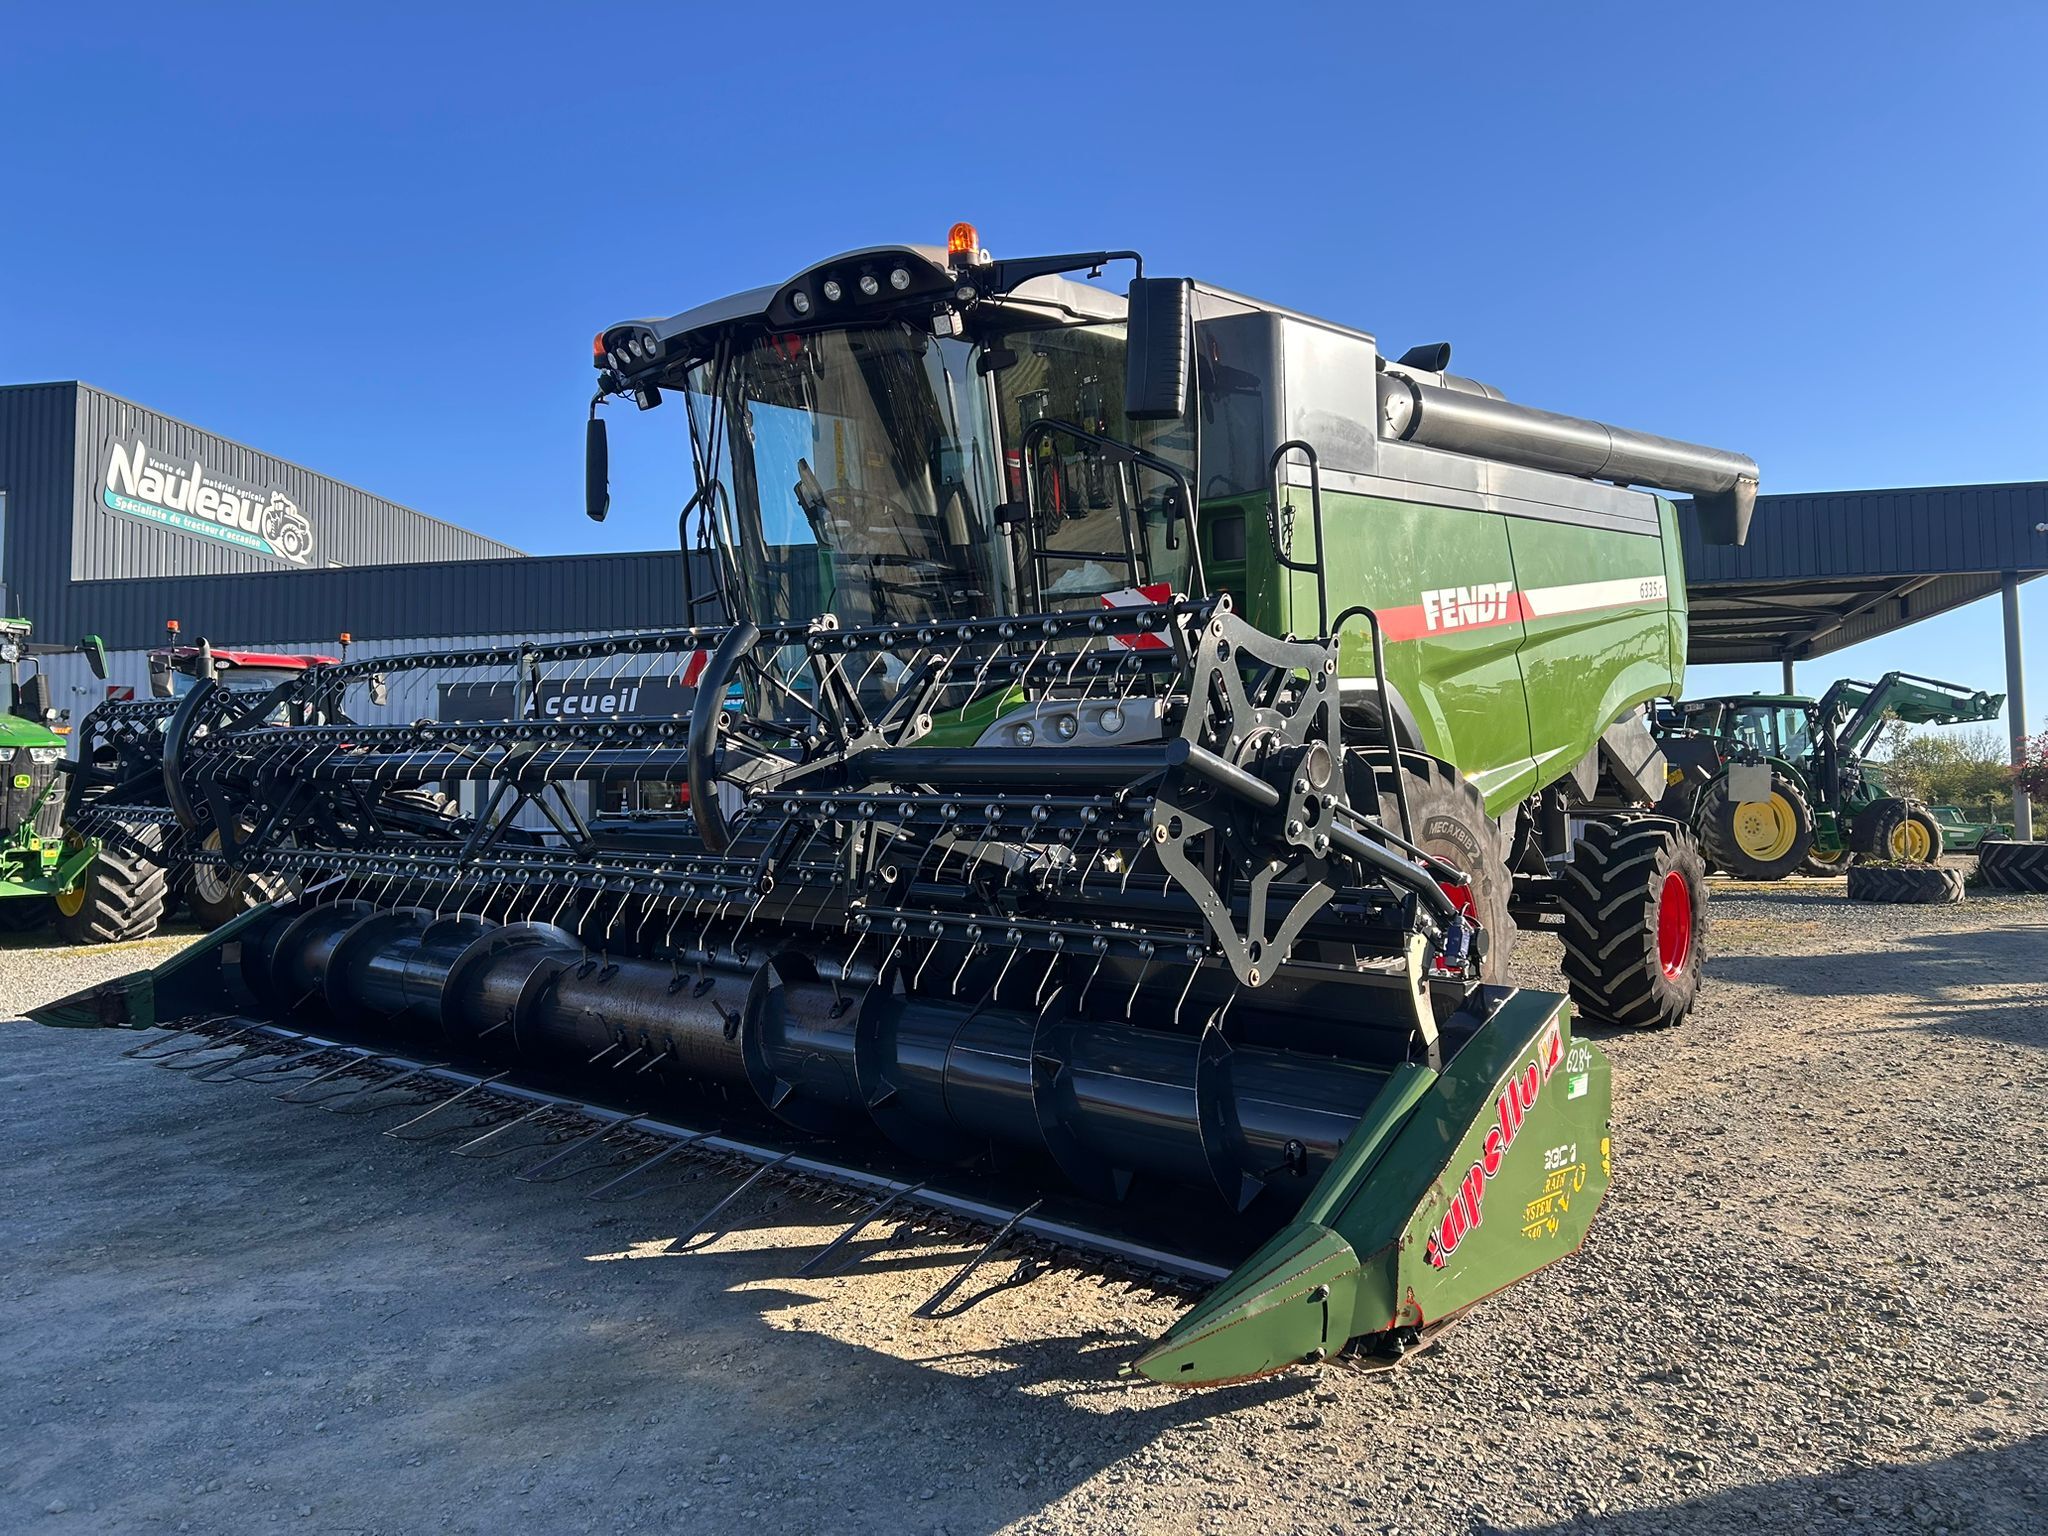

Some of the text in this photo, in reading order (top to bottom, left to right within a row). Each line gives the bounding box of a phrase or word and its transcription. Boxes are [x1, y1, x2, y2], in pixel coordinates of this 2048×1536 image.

[148, 457, 187, 477] Vente de
[106, 439, 264, 534] Nauleau
[202, 476, 266, 504] matériel agricole
[115, 496, 168, 522] Spécialiste
[170, 511, 181, 525] du
[183, 516, 219, 537] tracteur
[1639, 581, 1658, 599] 6335
[1420, 581, 1513, 631] FENDT
[523, 687, 639, 716] Accueil
[1428, 821, 1474, 851] MEGAXBIB
[1566, 1045, 1592, 1074] 6284
[1542, 1171, 1568, 1194] RAIN
[1522, 1197, 1553, 1222] YSTEM
